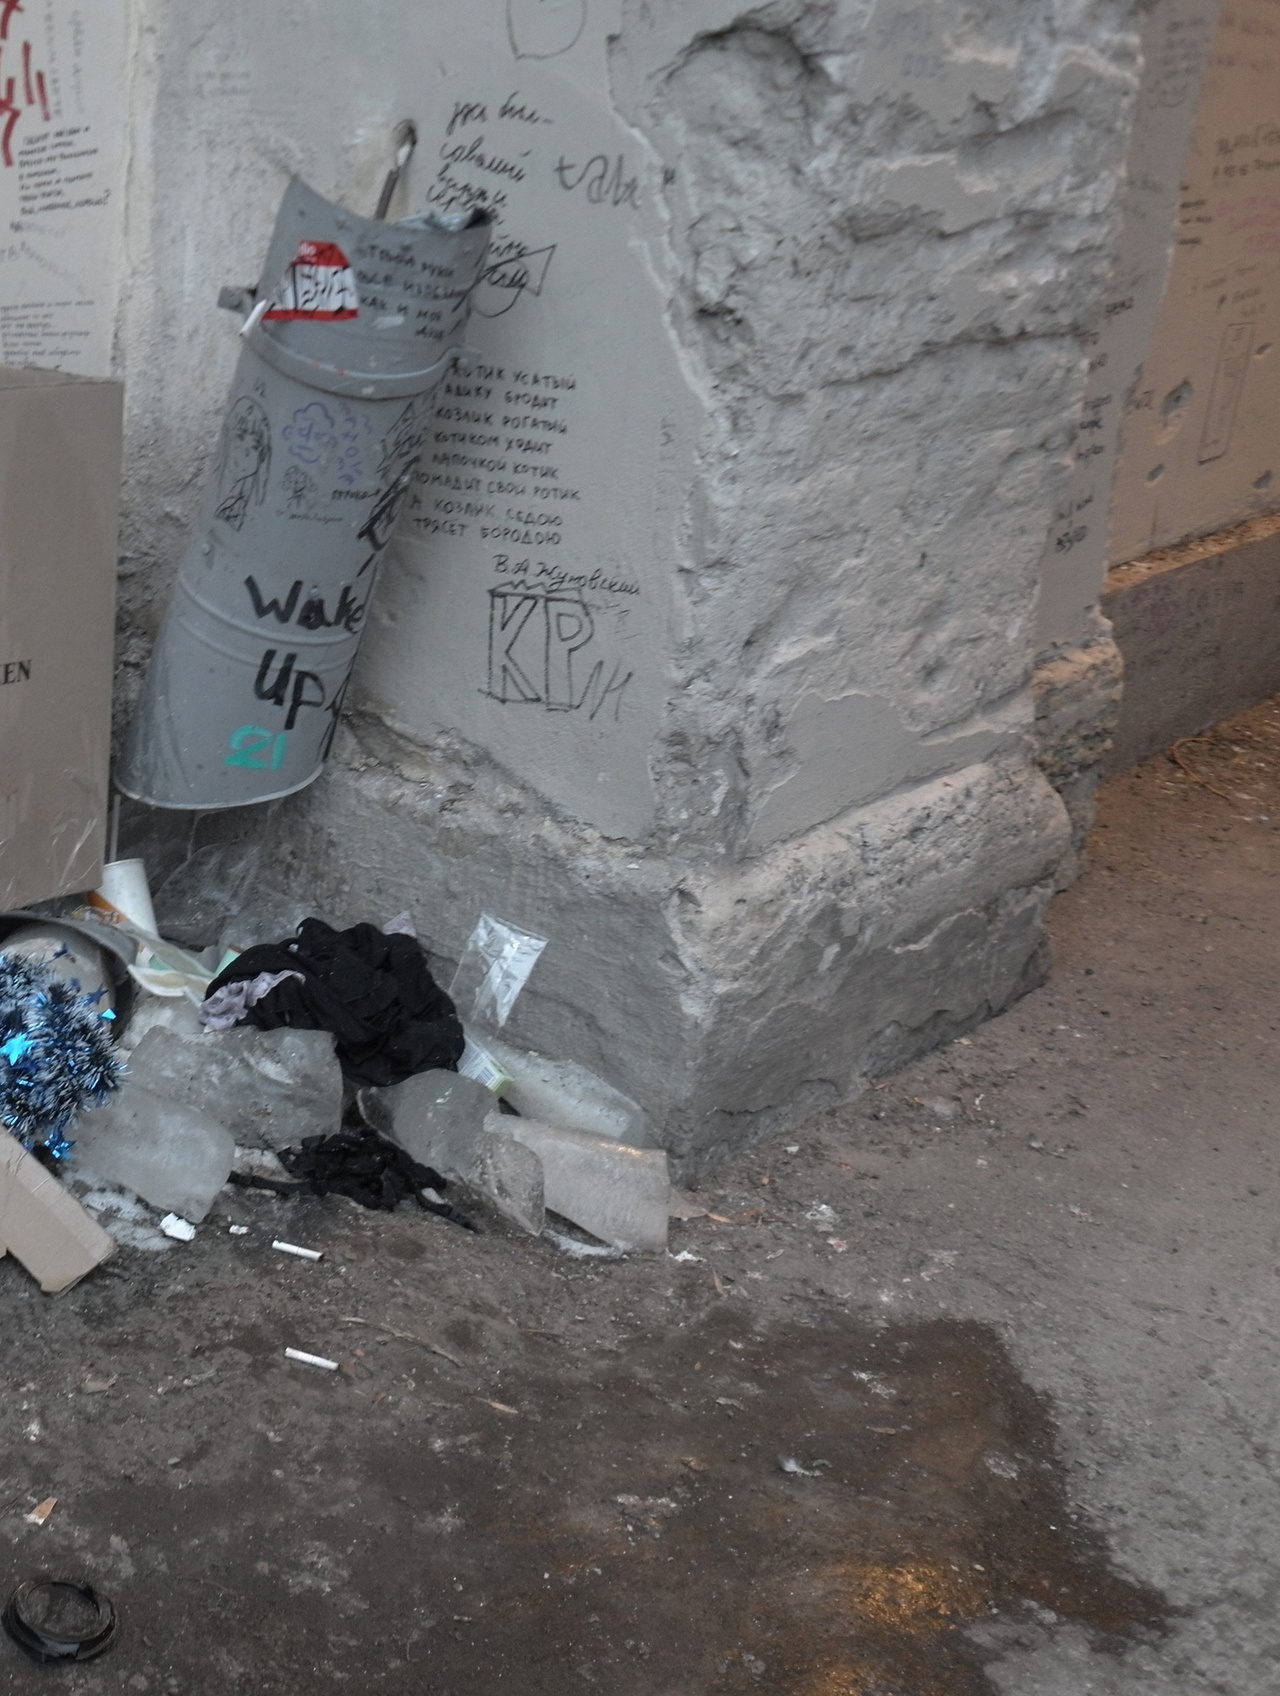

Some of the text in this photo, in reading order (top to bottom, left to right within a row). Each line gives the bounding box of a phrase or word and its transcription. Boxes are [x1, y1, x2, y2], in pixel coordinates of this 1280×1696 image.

[433, 431, 554, 455] КОТИКОМ ХОДИТ
[512, 460, 560, 481] КОТИК
[533, 485, 582, 502] РОТИК
[480, 525, 563, 546] БОРОДОЮ
